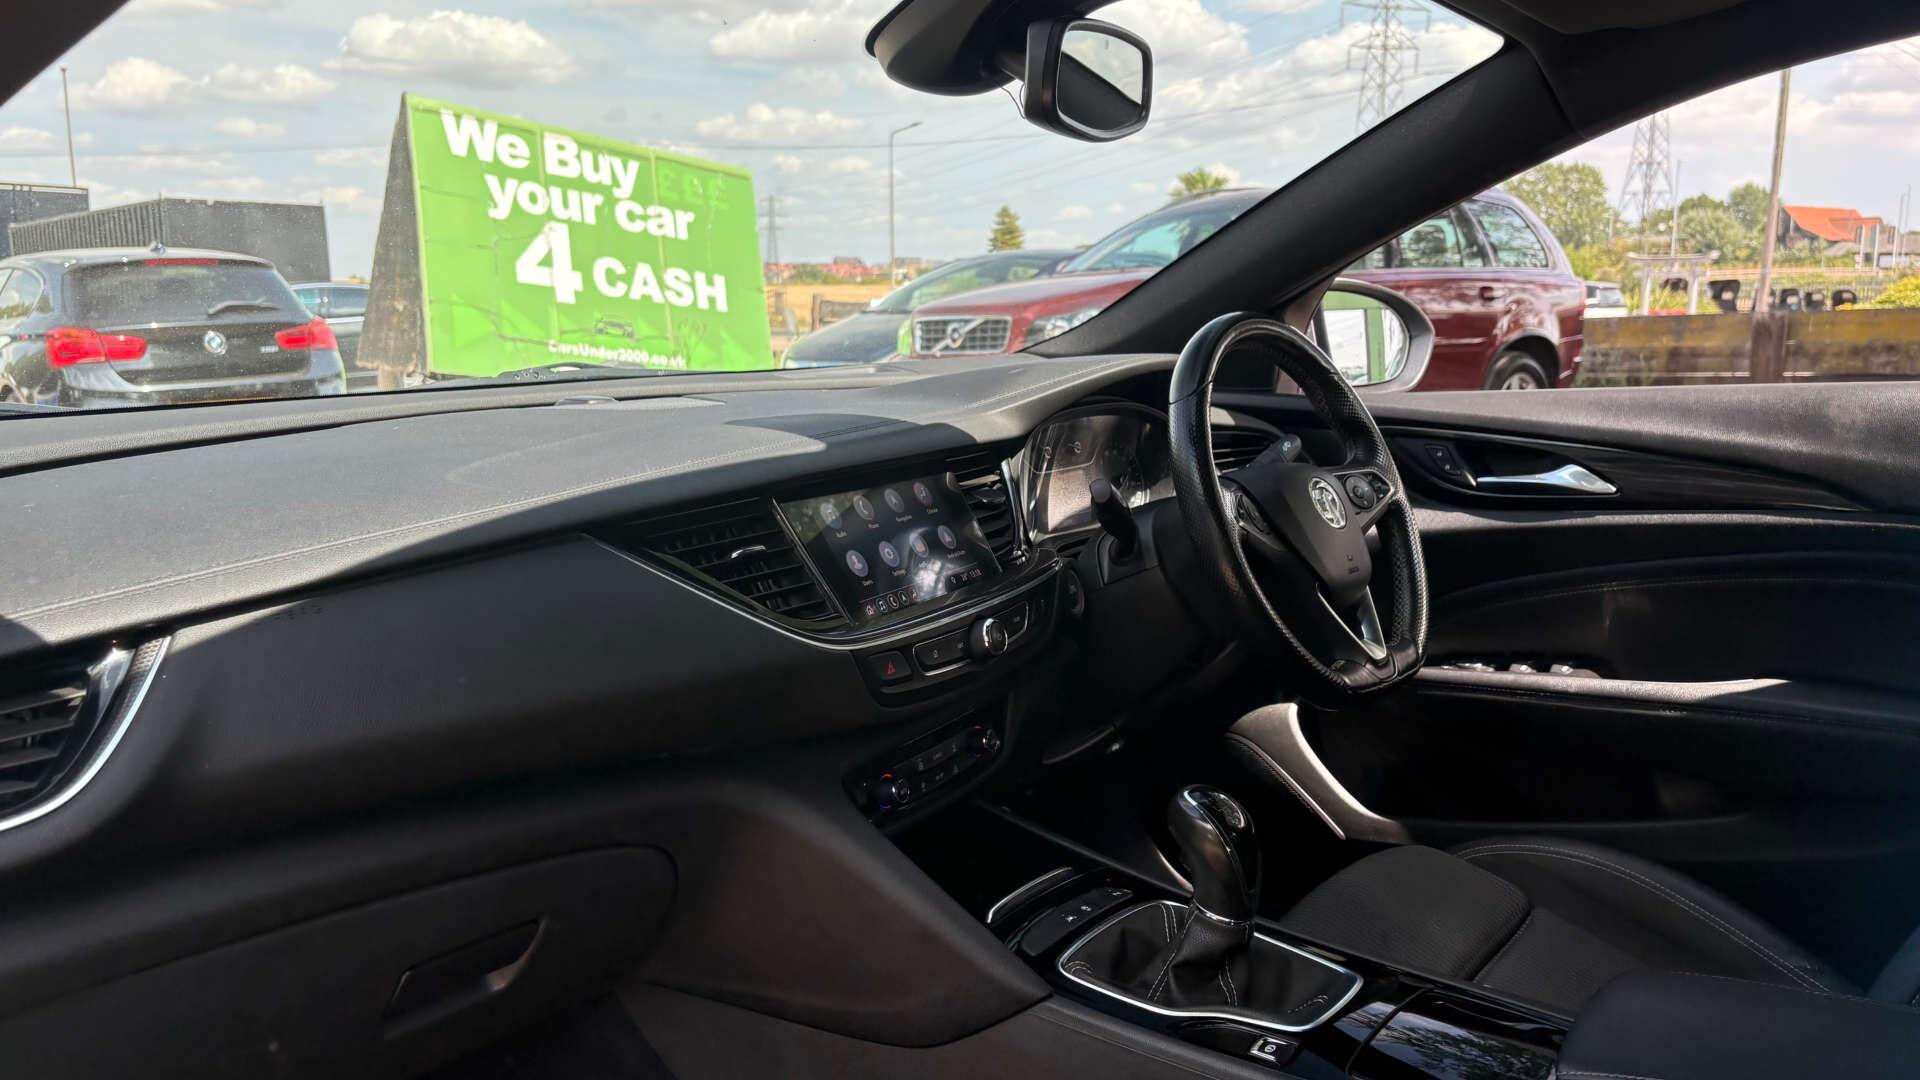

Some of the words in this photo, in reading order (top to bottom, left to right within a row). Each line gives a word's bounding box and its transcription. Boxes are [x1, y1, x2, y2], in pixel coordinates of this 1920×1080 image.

[440, 108, 530, 169] We
[543, 131, 640, 199] Buy
[485, 174, 605, 225] your
[614, 199, 696, 241] car
[515, 221, 584, 305] 4
[592, 256, 729, 313] CASH
